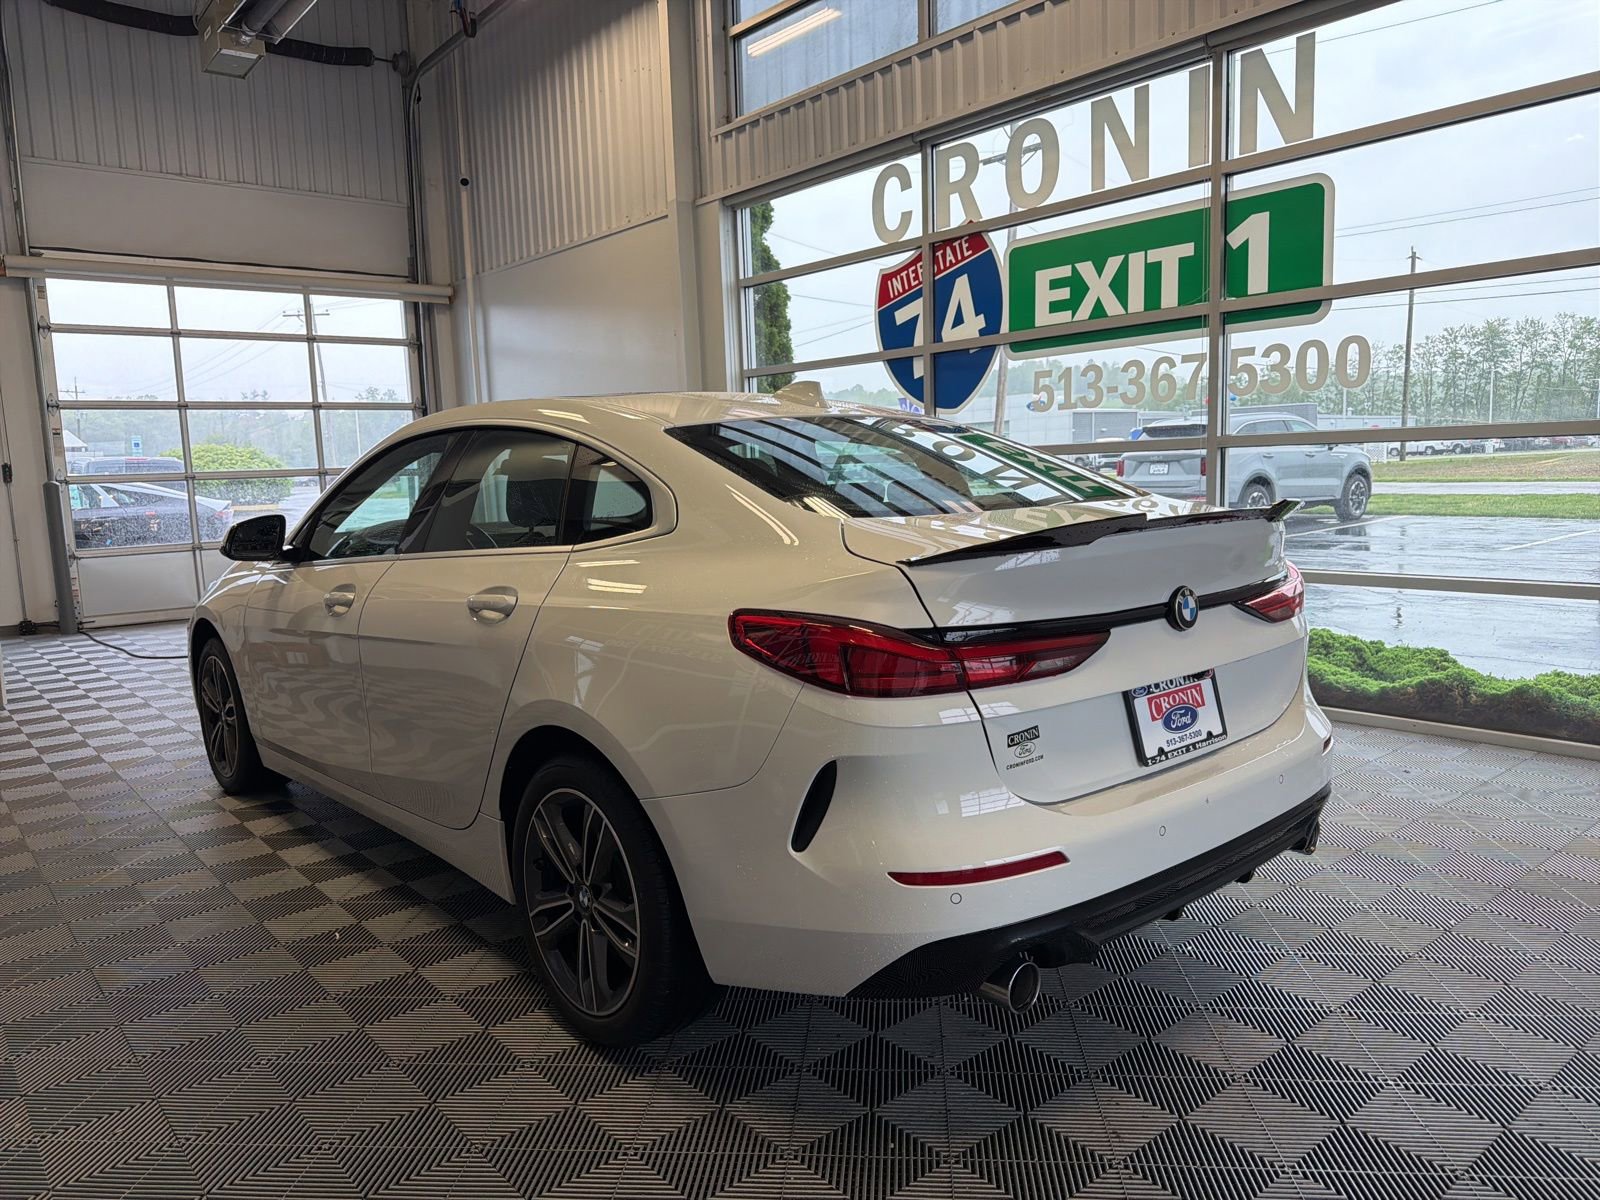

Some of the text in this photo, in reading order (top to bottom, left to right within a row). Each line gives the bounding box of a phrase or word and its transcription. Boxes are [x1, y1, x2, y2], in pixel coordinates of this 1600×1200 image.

[872, 31, 1316, 244] CRONIN
[887, 236, 973, 299] INTERTATE
[1034, 211, 1271, 327] EXIT 1
[894, 273, 986, 380] 74
[1032, 335, 1372, 413] 513-3675300
[1152, 686, 1202, 719] CRONIN
[1170, 709, 1192, 728] Ford
[1008, 727, 1039, 745] CRONIN
[1147, 754, 1166, 766] I-74
[1168, 747, 1187, 759] EXIT
[1196, 735, 1226, 748] Harrison
[1166, 729, 1202, 747] 513-367-5300
